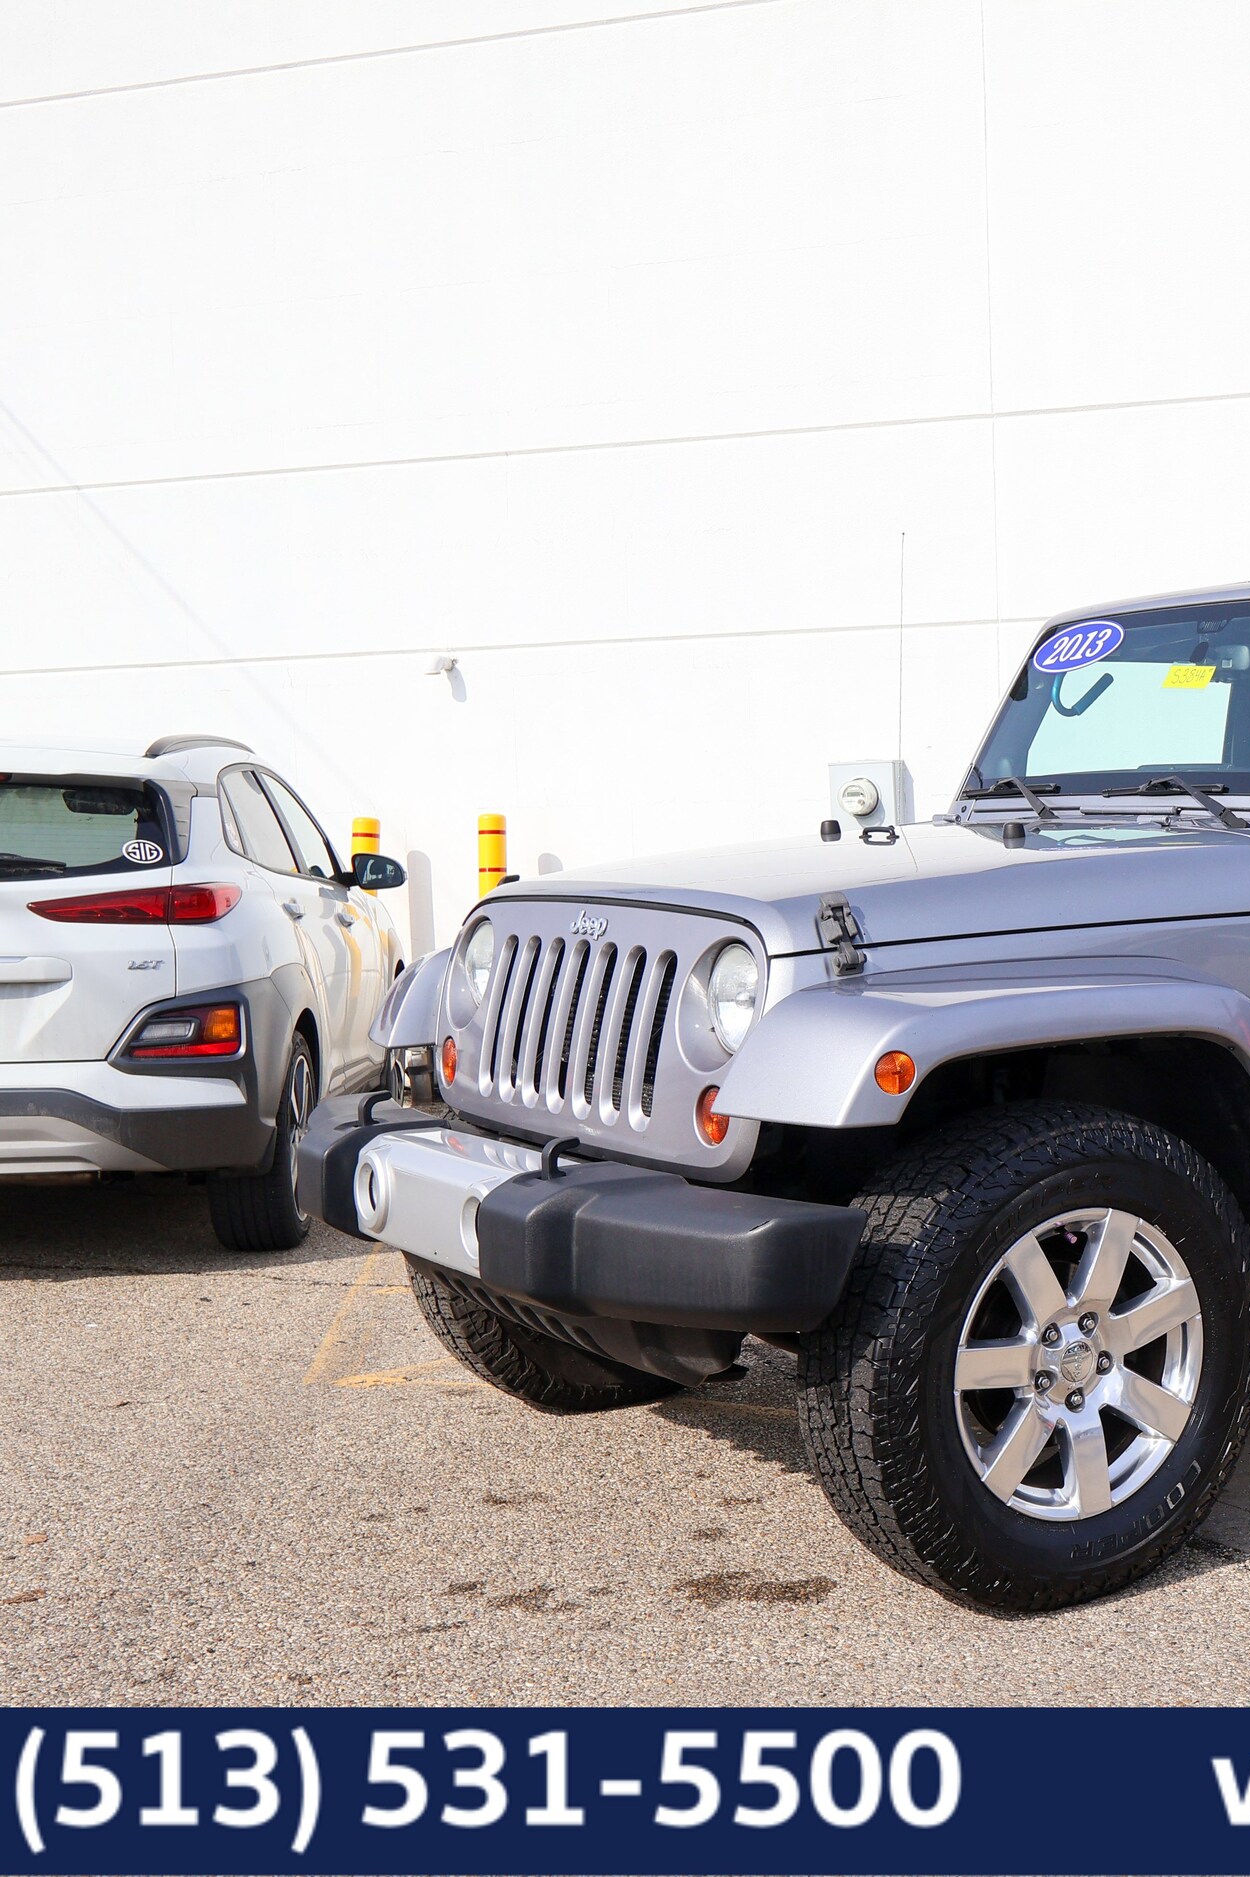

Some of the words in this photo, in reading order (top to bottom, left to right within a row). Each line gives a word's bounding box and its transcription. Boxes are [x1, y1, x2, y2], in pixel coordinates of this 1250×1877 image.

[1042, 628, 1113, 666] 2013
[127, 842, 159, 861] SIG
[570, 910, 608, 941] Jeep
